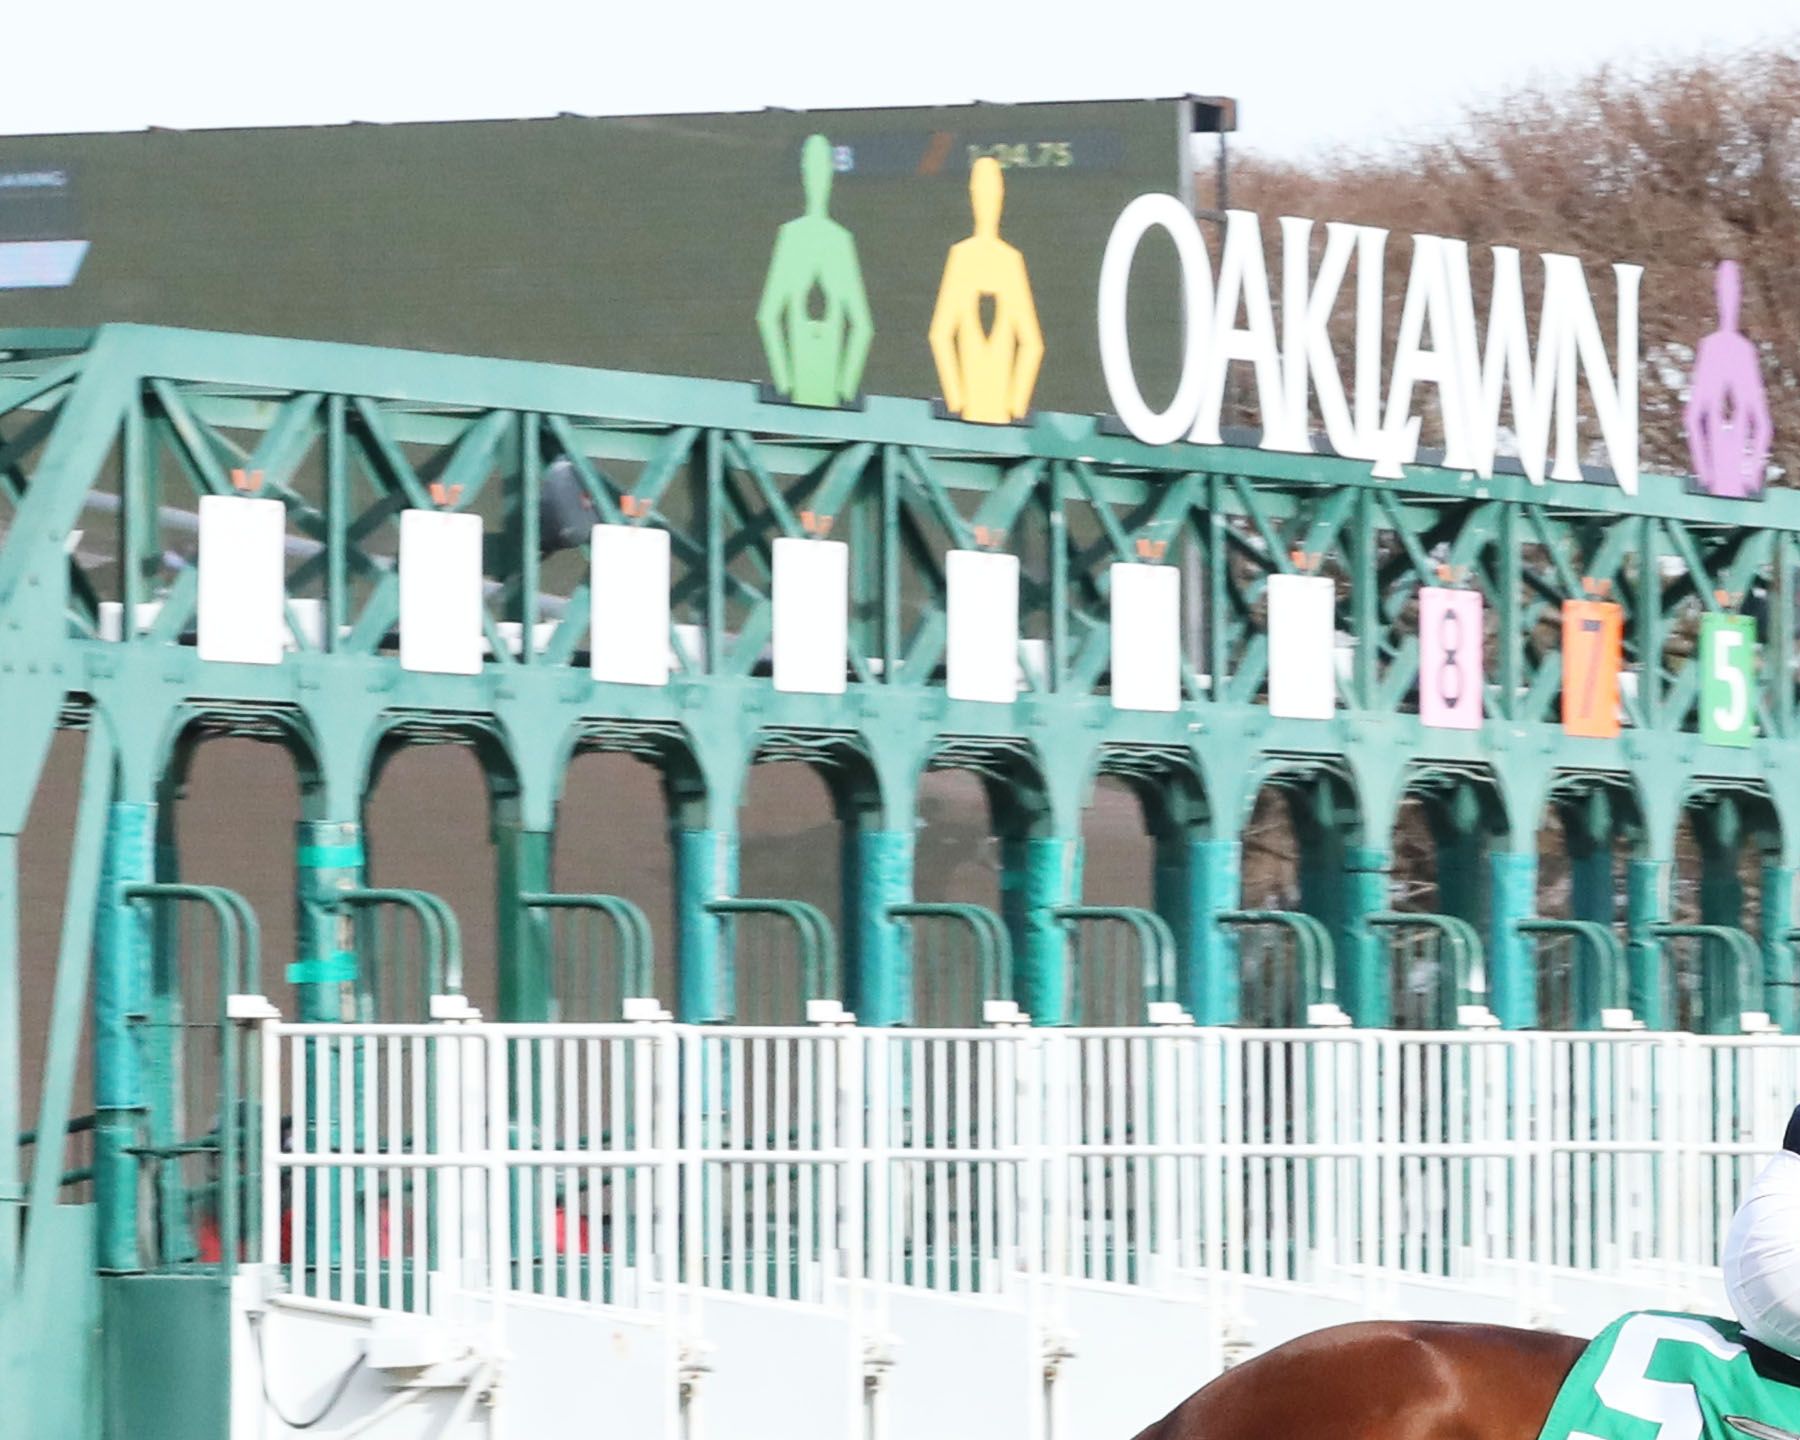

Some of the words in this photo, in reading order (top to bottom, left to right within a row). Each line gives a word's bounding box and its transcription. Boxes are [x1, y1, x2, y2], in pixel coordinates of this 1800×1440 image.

[1098, 193, 1644, 496] OAKLAWN
[1436, 608, 1465, 709] 8
[1578, 618, 1607, 719] 7
[1713, 630, 1747, 733] 5
